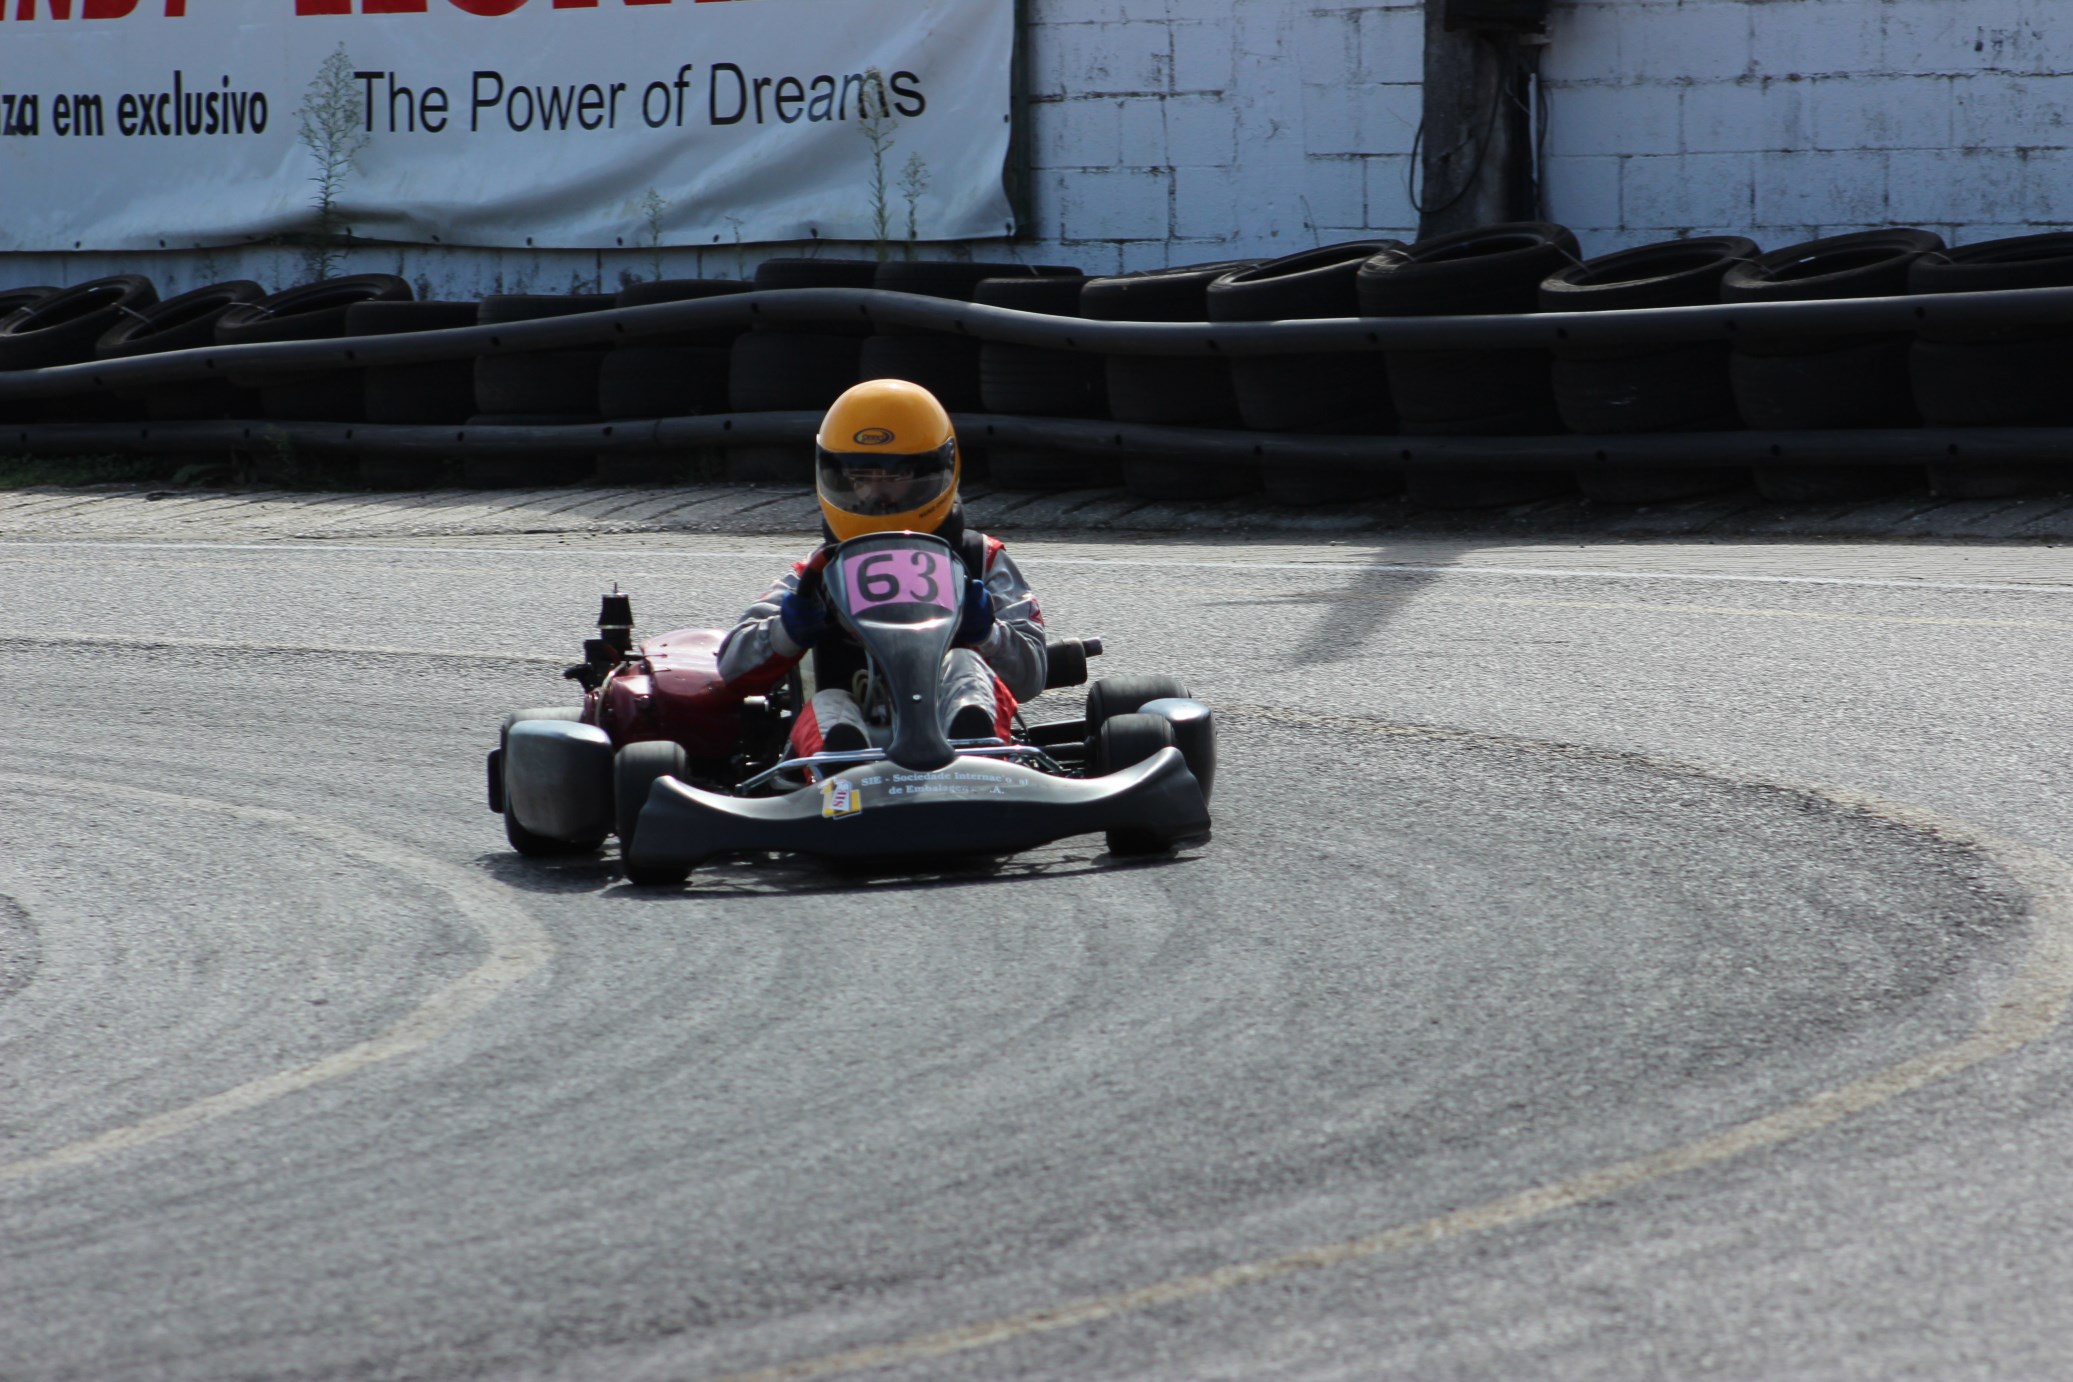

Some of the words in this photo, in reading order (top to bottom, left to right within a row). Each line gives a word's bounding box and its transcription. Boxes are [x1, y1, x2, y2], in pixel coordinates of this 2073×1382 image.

[52, 93, 104, 136] em
[117, 70, 268, 137] exclusivo
[354, 71, 448, 133] The
[471, 70, 626, 132] Power
[642, 63, 692, 127] of
[709, 62, 926, 126] Dreams
[857, 551, 939, 603] 63
[861, 775, 883, 787] SIE
[892, 772, 951, 783] Sociedade
[954, 772, 1029, 786] Internacoal
[888, 785, 903, 795] de
